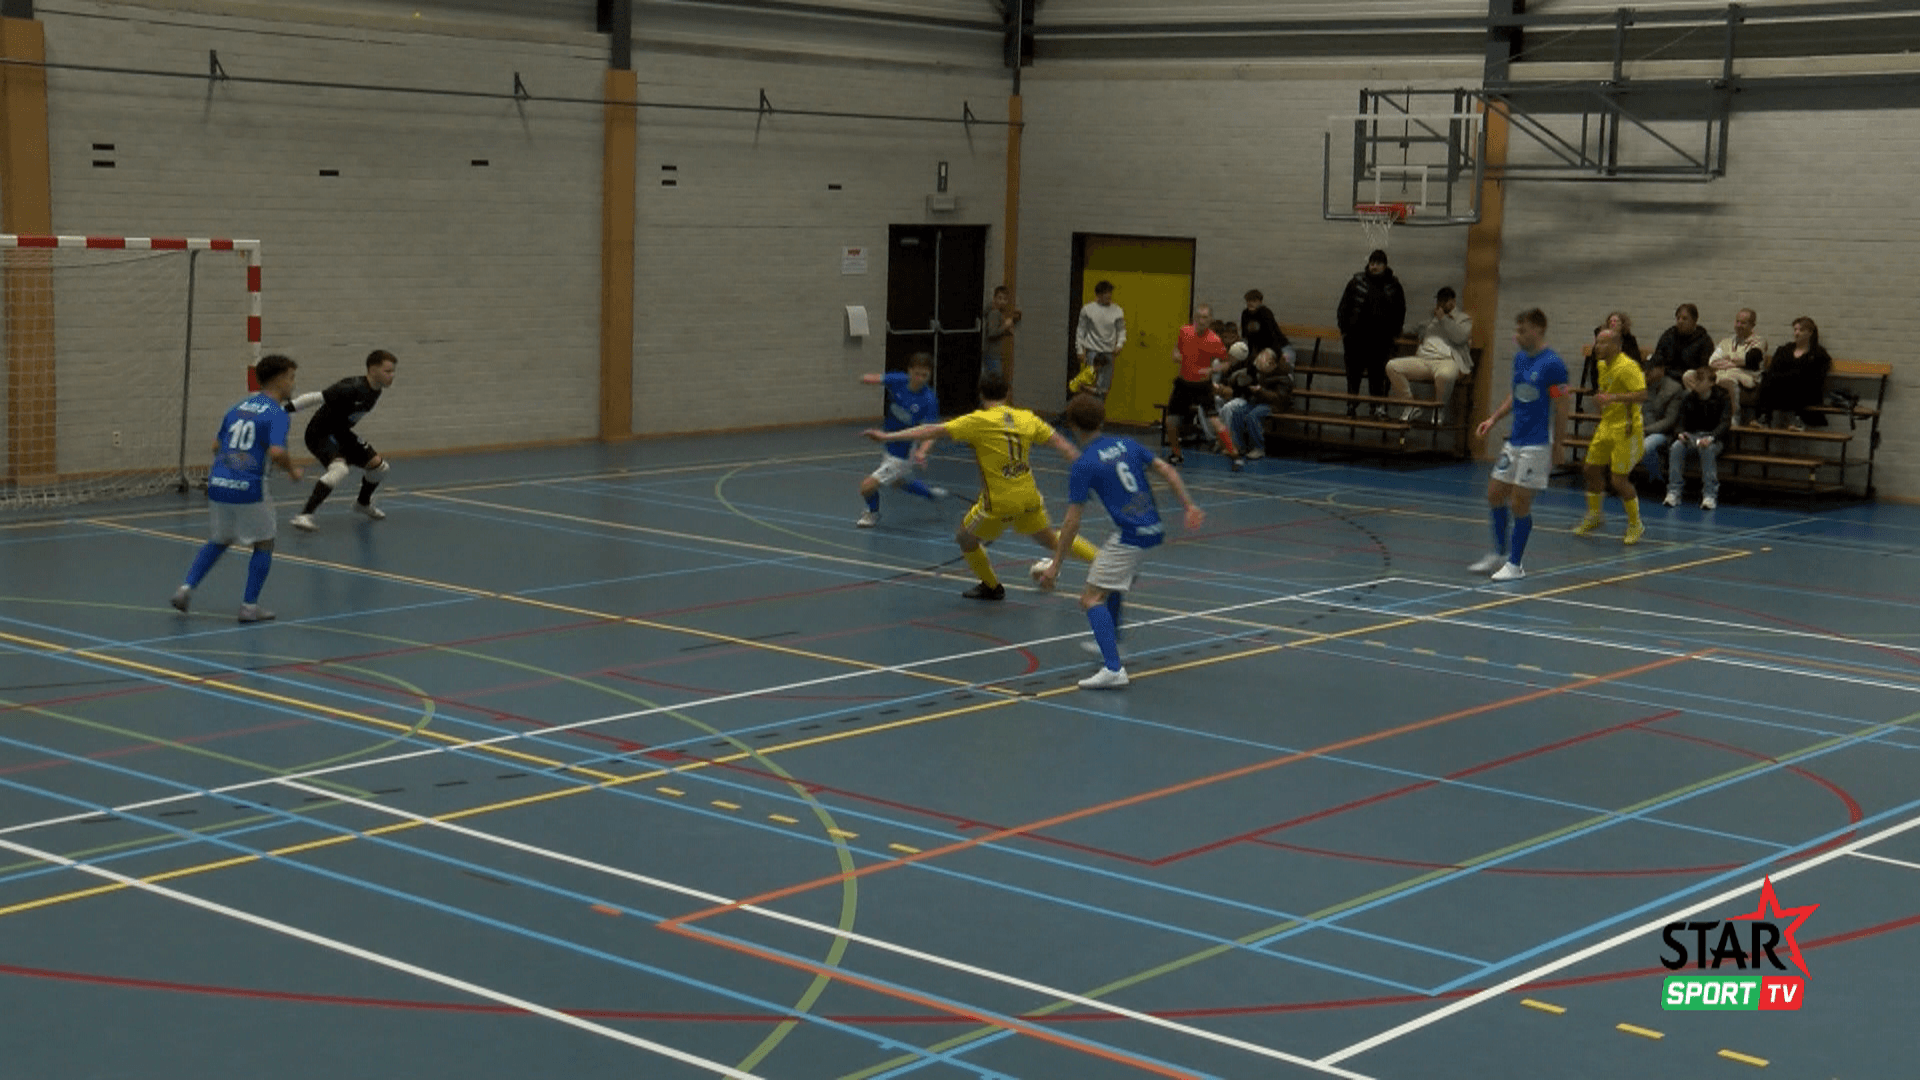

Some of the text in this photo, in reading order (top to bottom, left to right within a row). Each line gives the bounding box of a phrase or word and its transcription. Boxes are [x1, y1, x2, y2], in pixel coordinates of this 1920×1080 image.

[228, 419, 256, 451] 10
[1003, 431, 1023, 462] 11
[1116, 461, 1138, 493] 6
